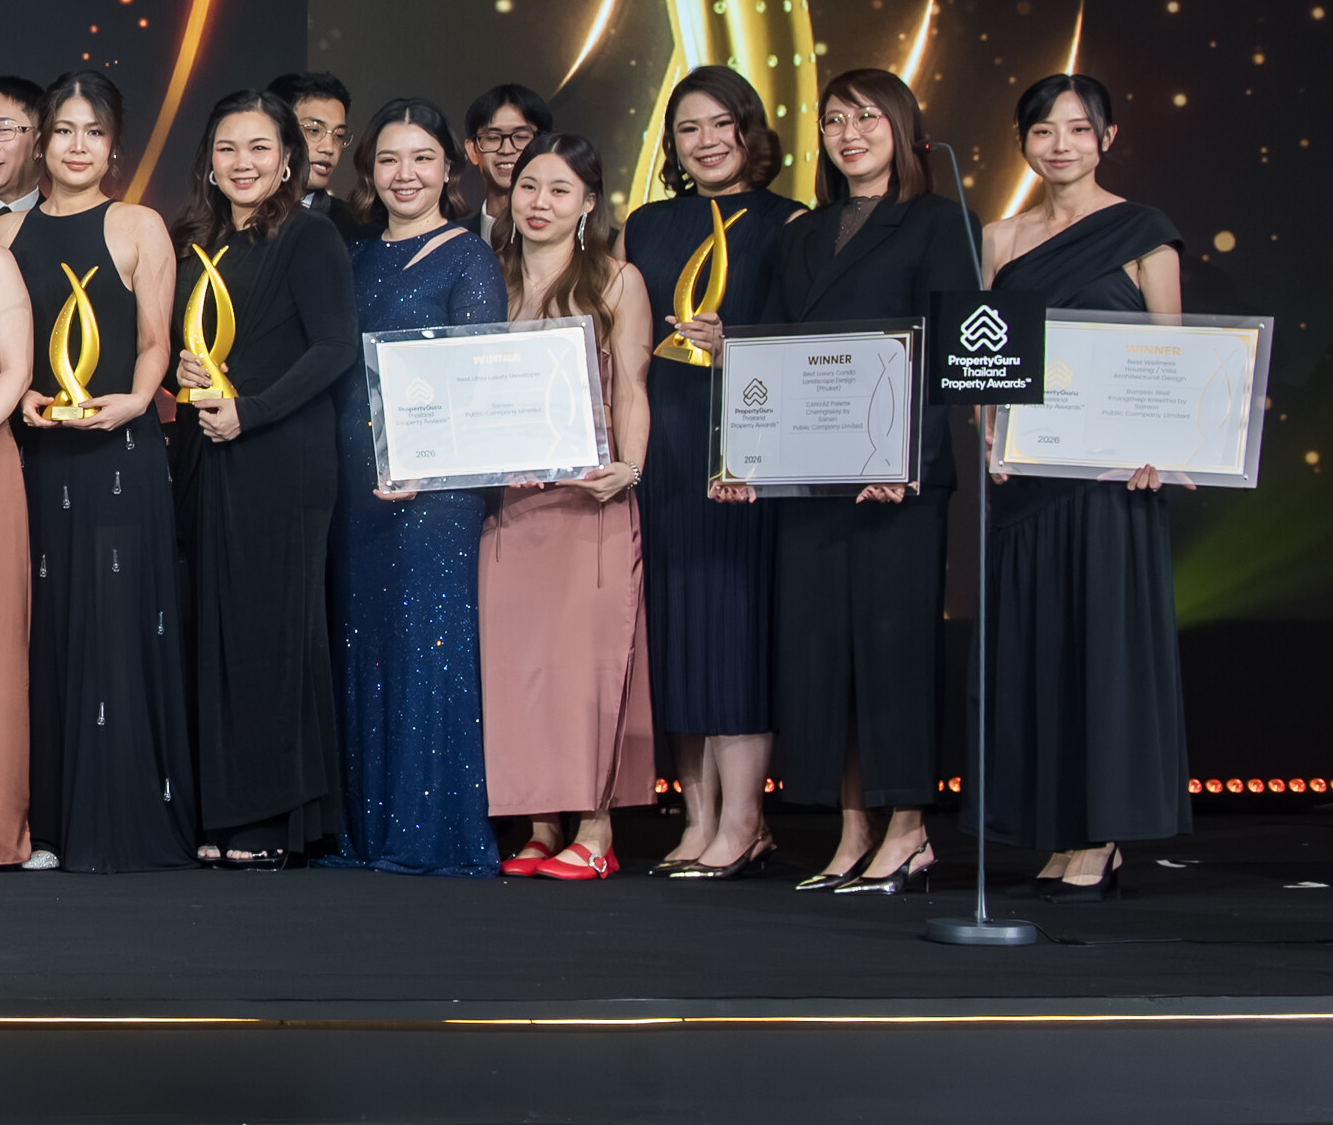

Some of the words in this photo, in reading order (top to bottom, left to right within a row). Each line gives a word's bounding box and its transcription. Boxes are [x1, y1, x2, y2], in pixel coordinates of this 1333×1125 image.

[1125, 345, 1181, 356] WINNER
[808, 354, 852, 365] WINNER
[948, 355, 1021, 367] PropertyGuru
[963, 367, 1007, 377] Thailand
[941, 378, 985, 391] Property
[1037, 435, 1060, 443] 2026
[416, 449, 436, 458] 2026
[745, 455, 762, 463] 2026
